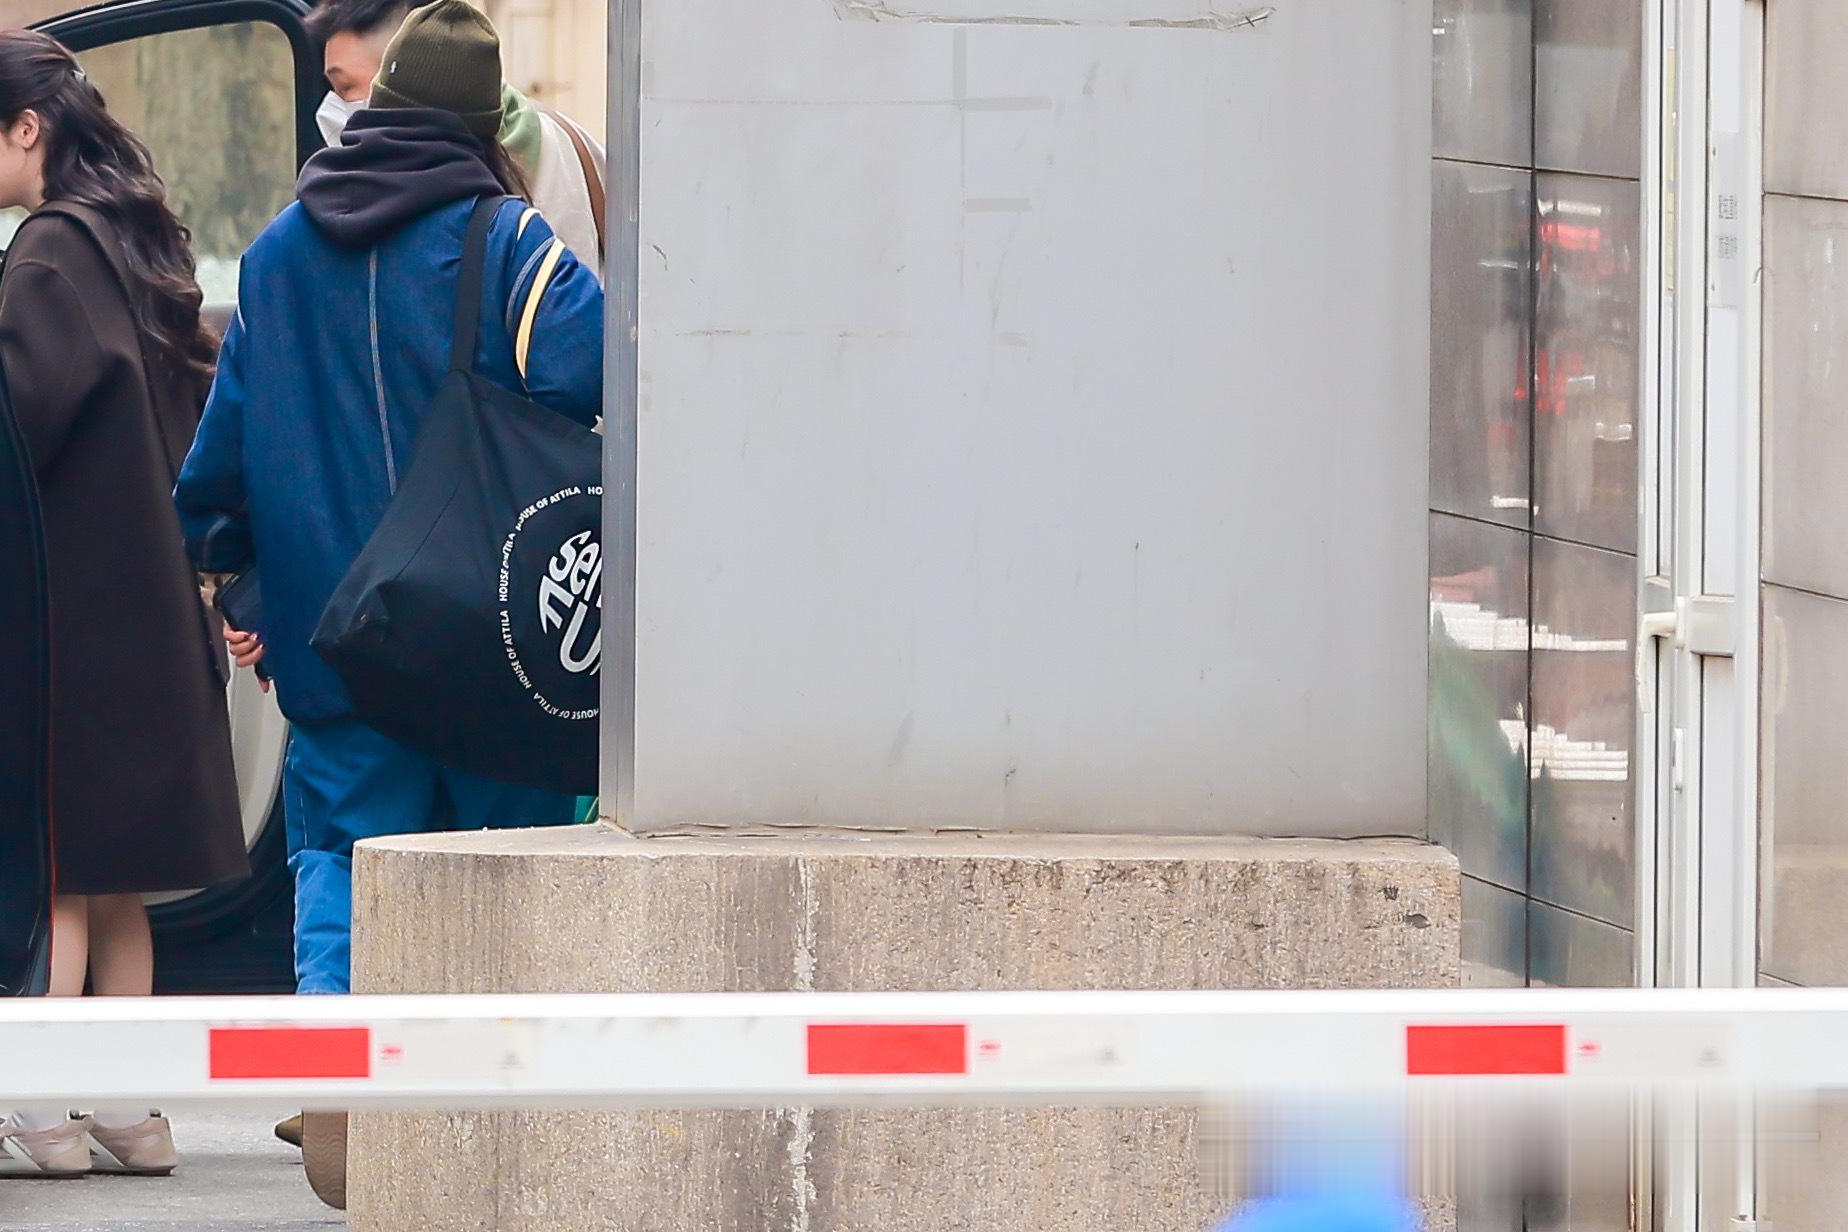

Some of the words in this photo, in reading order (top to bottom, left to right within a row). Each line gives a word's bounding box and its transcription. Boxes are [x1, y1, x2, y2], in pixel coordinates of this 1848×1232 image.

[549, 486, 581, 504] ATTILA
[498, 569, 510, 602] HOUSE
[499, 610, 513, 645] ATTILA
[511, 660, 532, 689] HOUSE
